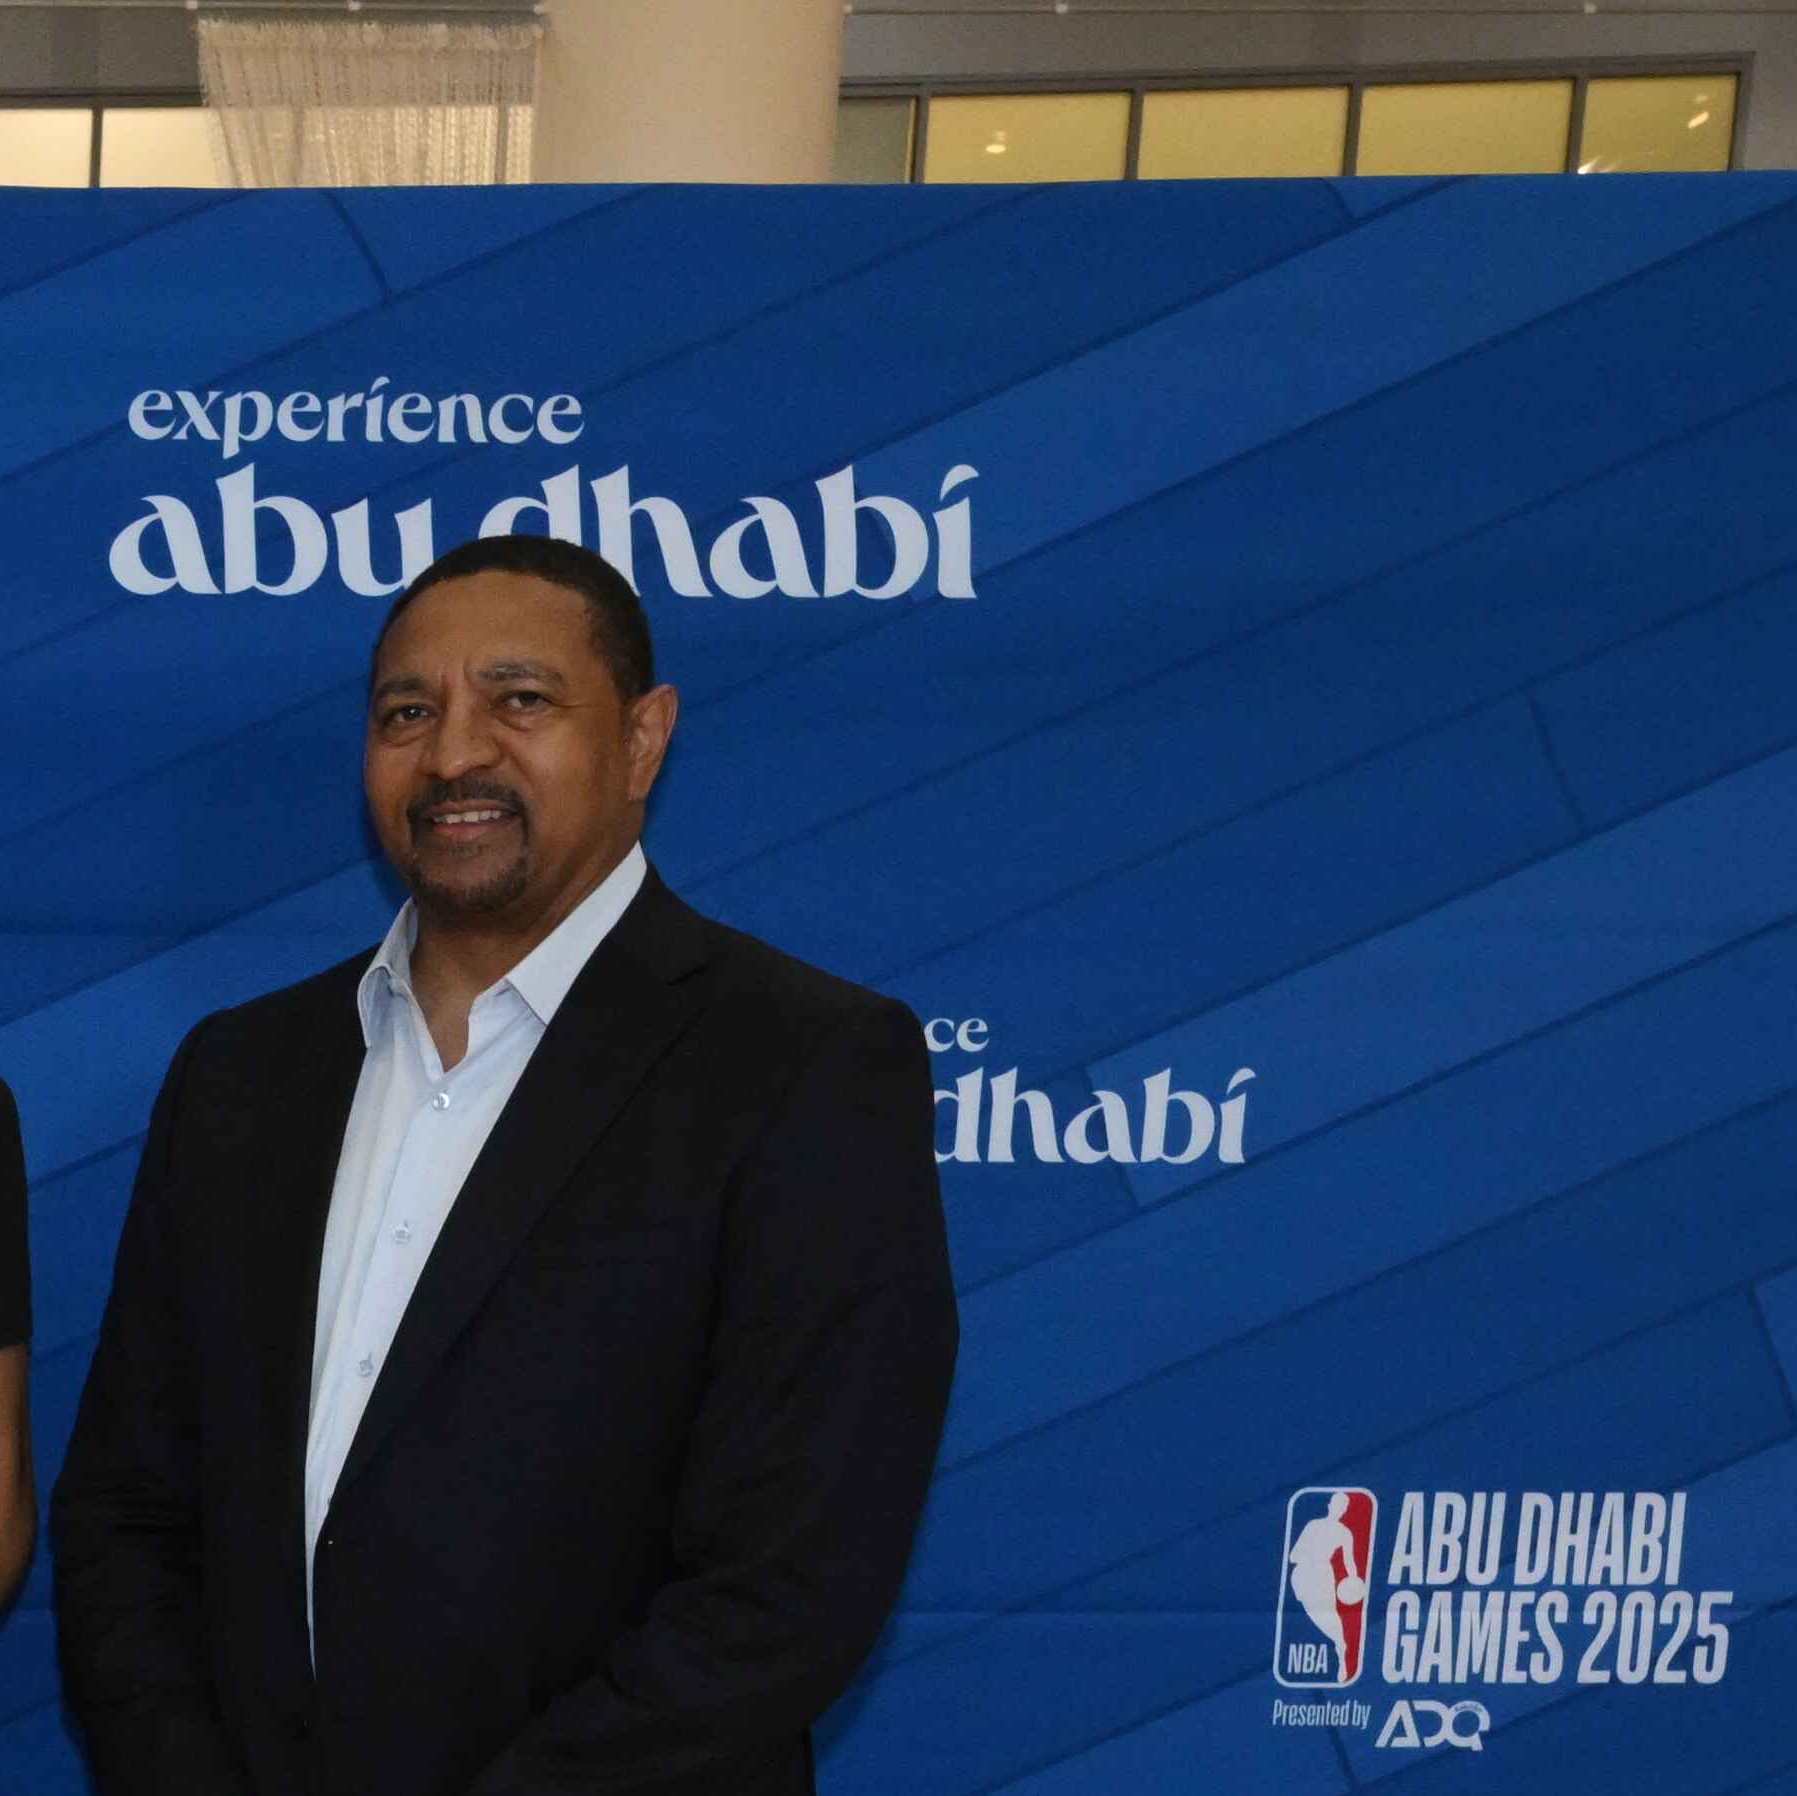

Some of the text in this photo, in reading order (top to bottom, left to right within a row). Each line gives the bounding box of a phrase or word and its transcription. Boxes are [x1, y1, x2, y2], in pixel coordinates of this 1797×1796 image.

[108, 463, 434, 598] abu
[1387, 1491, 1687, 1586] ABU DHABI
[1287, 1643, 1328, 1674] NBA
[1381, 1590, 1734, 1684] GAMES 2025
[1272, 1698, 1372, 1730] Presented by
[1374, 1699, 1491, 1751] ADQ
